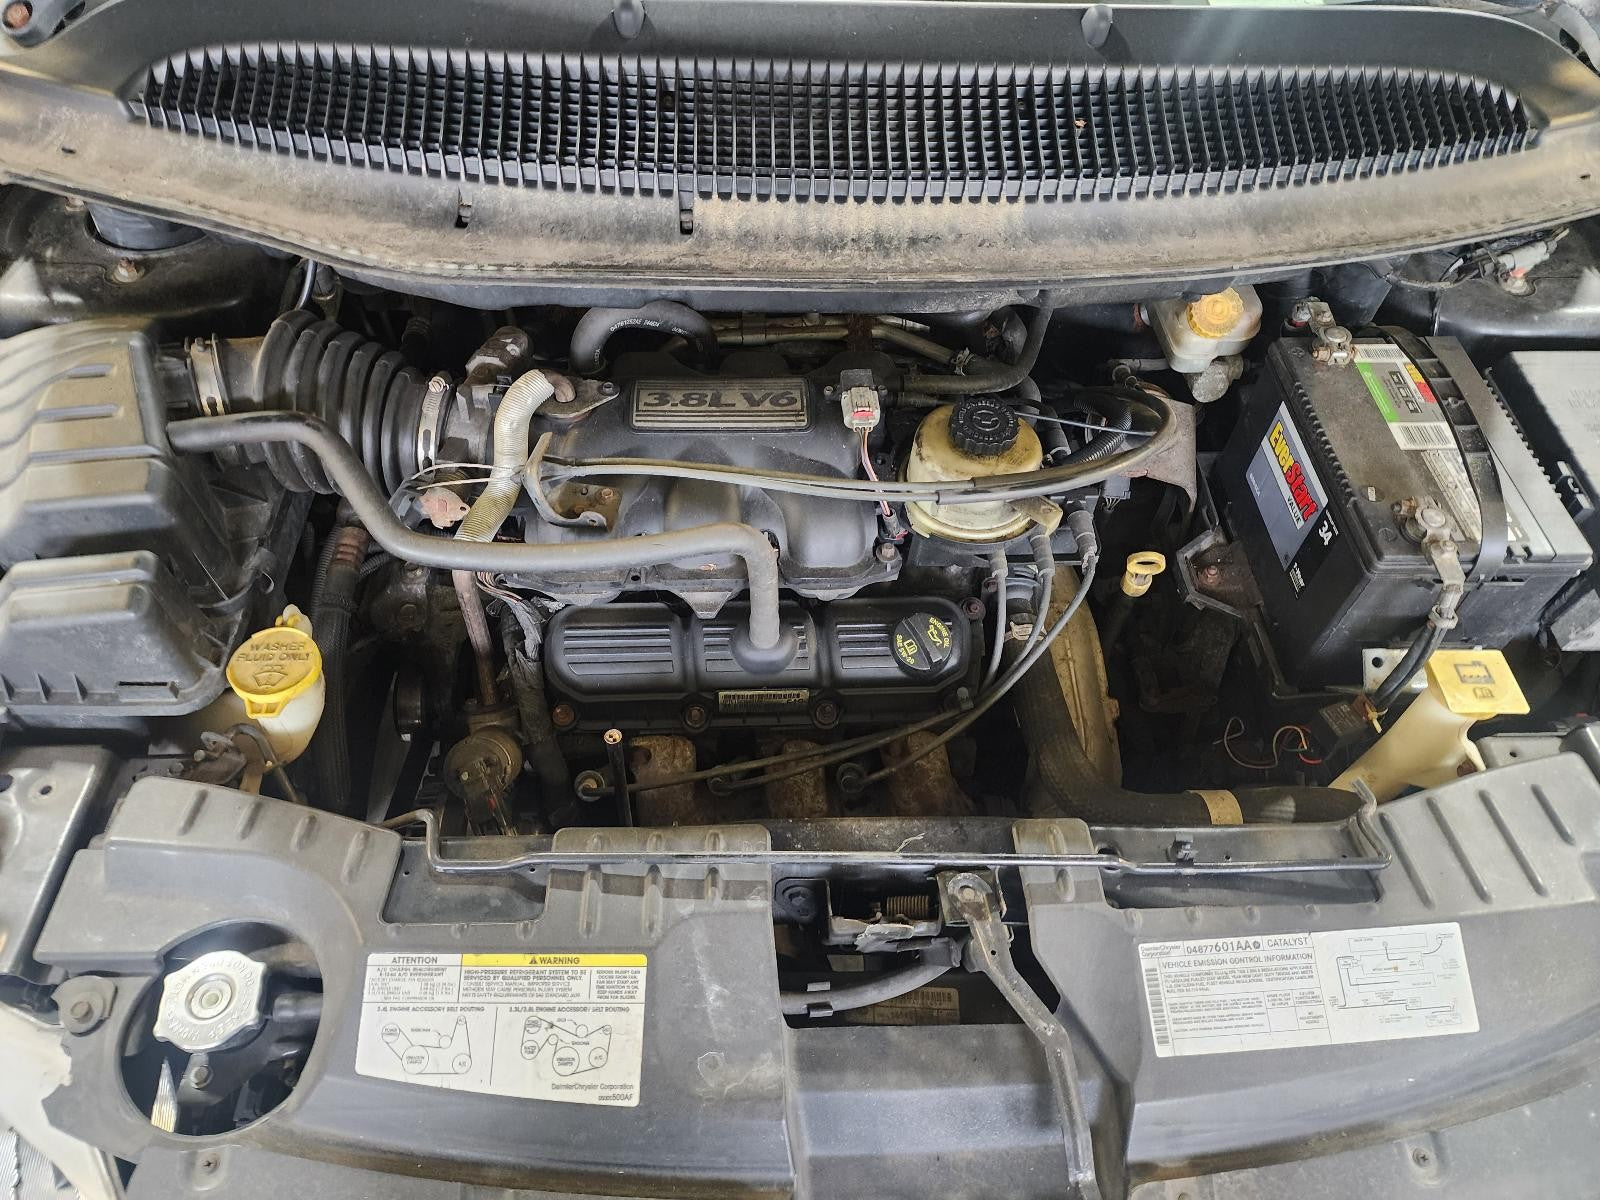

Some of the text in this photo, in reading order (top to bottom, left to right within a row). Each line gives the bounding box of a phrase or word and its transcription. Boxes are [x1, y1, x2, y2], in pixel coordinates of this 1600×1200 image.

[644, 391, 797, 408] 3.8L V6
[1269, 420, 1318, 521] EverStart
[1288, 494, 1302, 524] VALUE
[1318, 520, 1333, 546] 34
[929, 617, 948, 637] ENGINE
[250, 642, 305, 650] WASHER
[237, 653, 275, 661] FLUID
[1268, 937, 1308, 947] CATALYST
[1161, 960, 1193, 968] VEHICLE
[1194, 958, 1228, 967] EMISSION
[1264, 953, 1312, 962] INFORMATION
